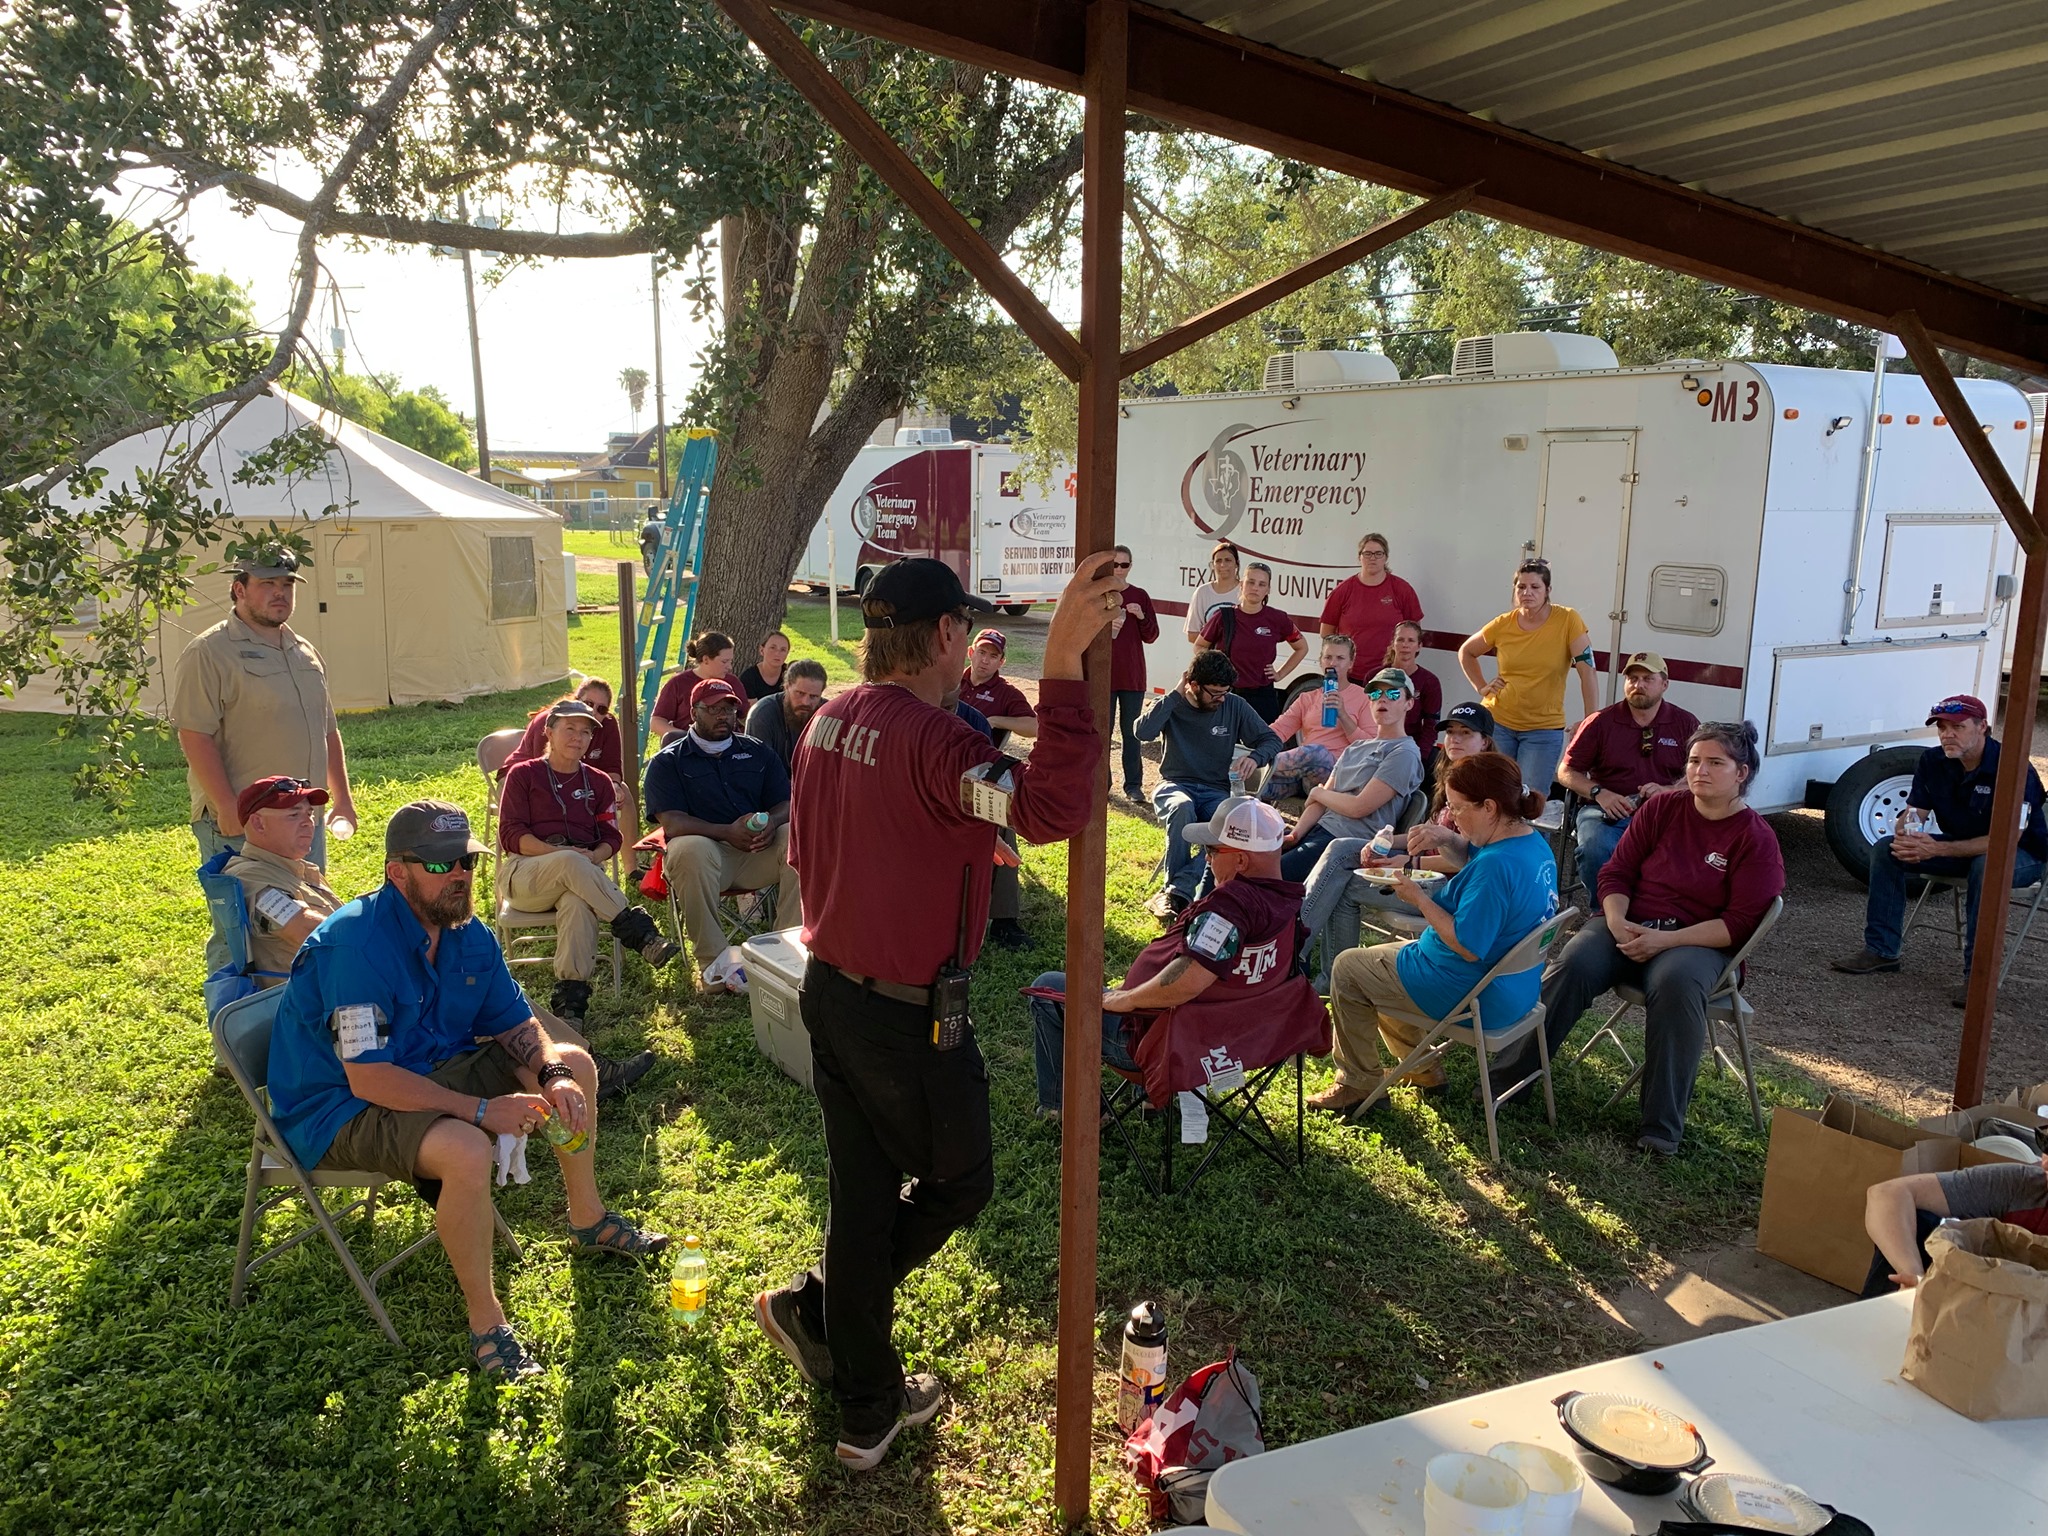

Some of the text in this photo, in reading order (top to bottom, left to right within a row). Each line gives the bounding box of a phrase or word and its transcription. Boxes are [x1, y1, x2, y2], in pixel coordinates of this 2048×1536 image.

[1250, 443, 1366, 482] Veterinary
[1248, 476, 1366, 515] Emergency
[876, 494, 917, 514] Veterinary
[876, 510, 918, 530] Emergency
[1032, 512, 1066, 523] Veterinary
[1032, 520, 1066, 530] Emergency
[1247, 508, 1304, 536] Team
[876, 524, 898, 540] Team
[1032, 528, 1050, 536] Team
[1004, 546, 1076, 560] SERVING OUR STAT
[1002, 562, 1075, 576] & NATION EVERY DA
[1180, 566, 1344, 600] TEXA UNIVE
[1452, 707, 1476, 716] WOOF
[974, 788, 982, 814] Wesley
[1209, 924, 1223, 934] Troy
[342, 1022, 372, 1031] Michael
